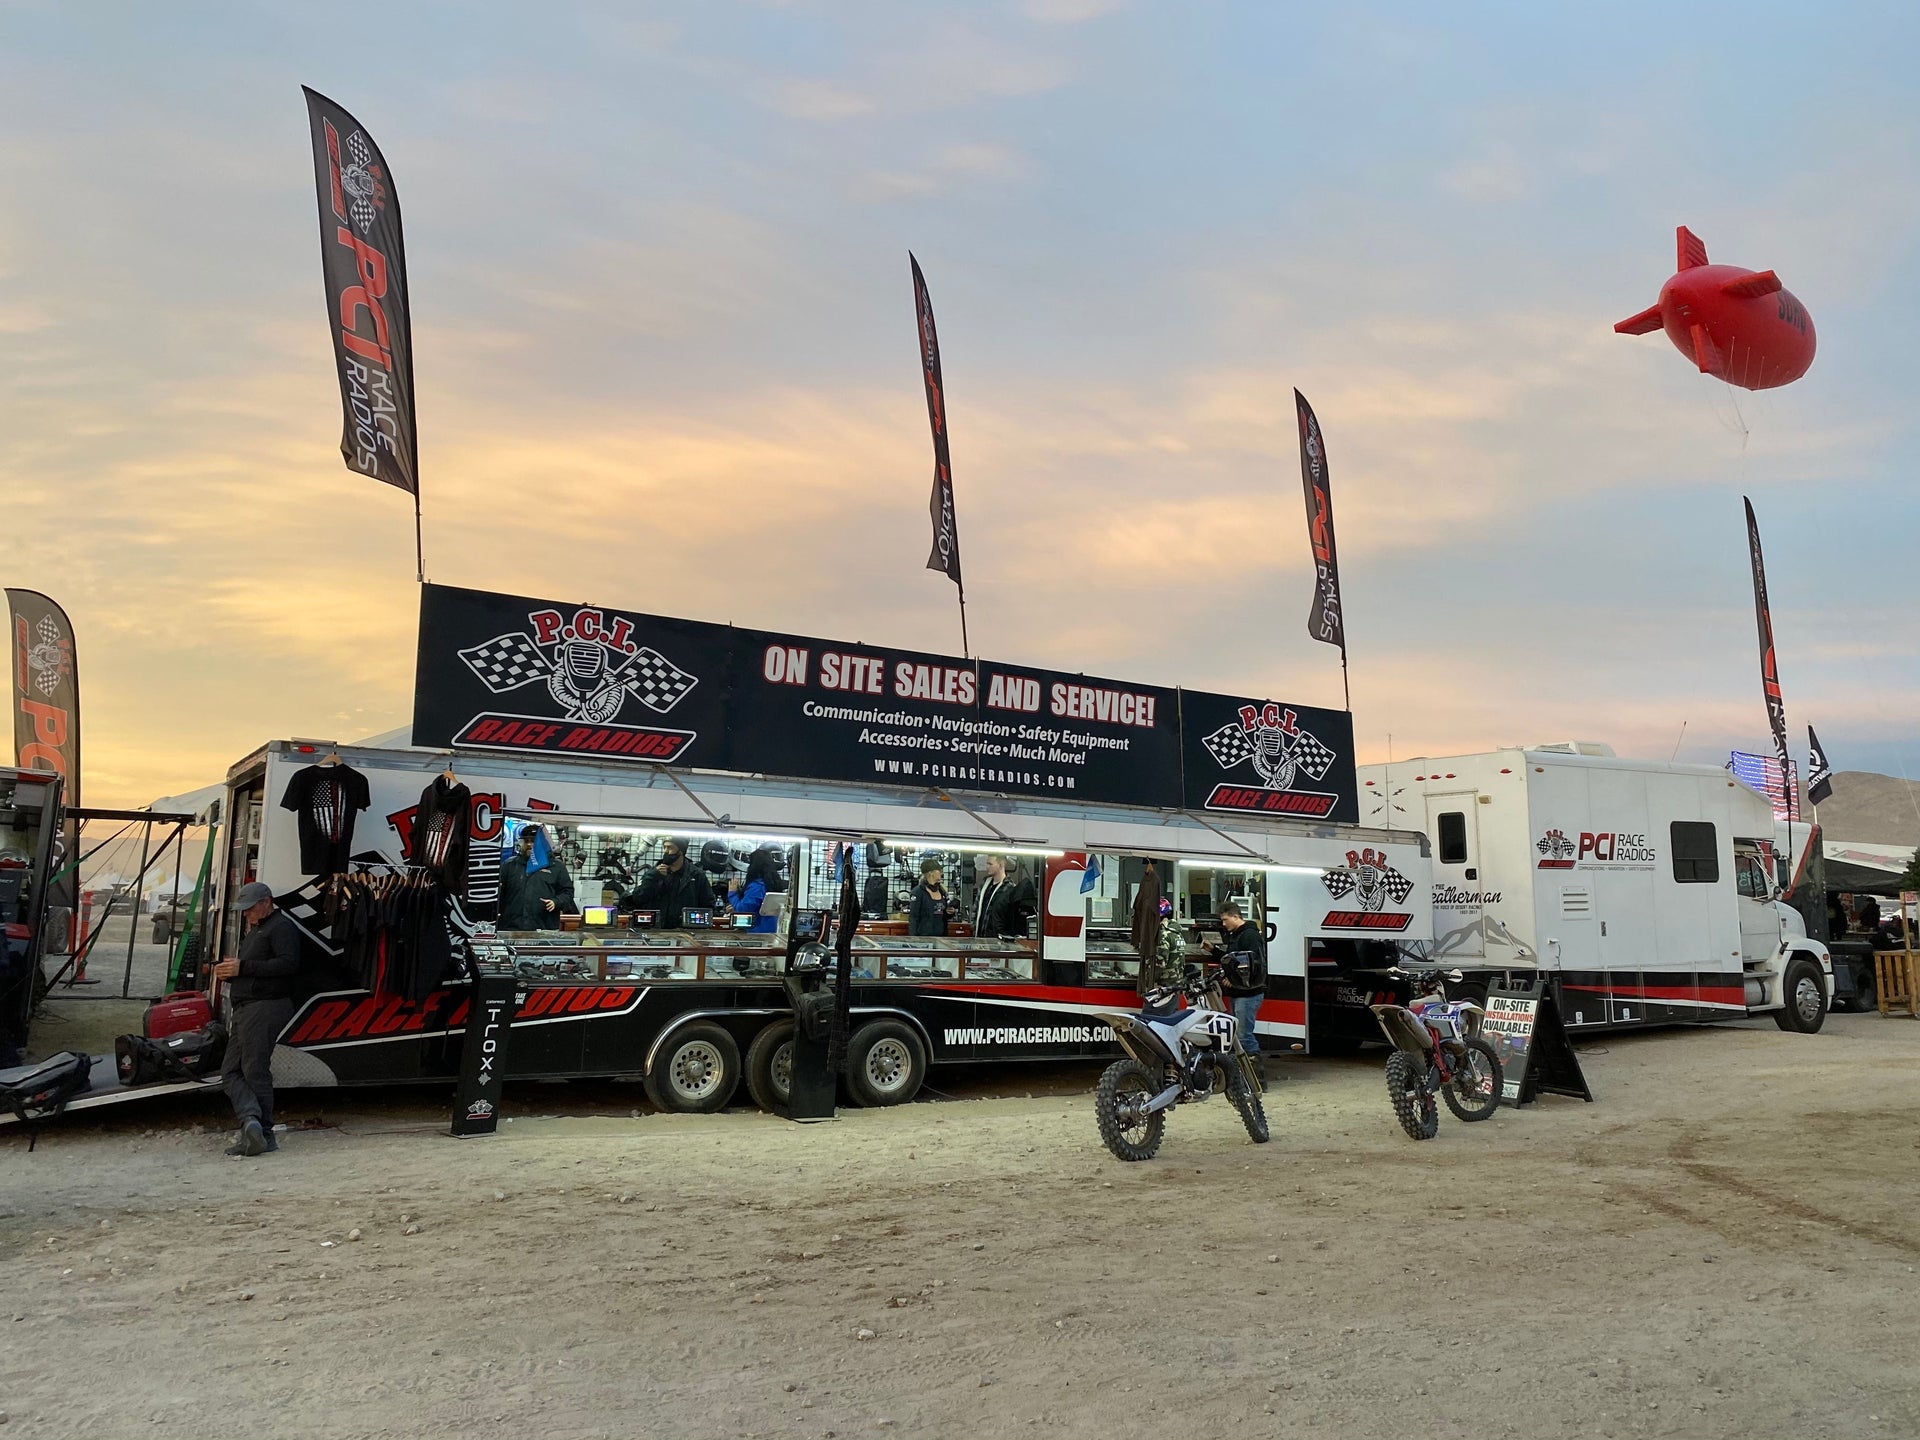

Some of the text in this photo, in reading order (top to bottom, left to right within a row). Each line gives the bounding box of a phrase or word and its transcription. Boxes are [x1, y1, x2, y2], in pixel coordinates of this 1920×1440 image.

[337, 226, 392, 371] PCI
[345, 356, 378, 475] RADIOS
[371, 369, 397, 456] RACE
[529, 609, 637, 654] P.C.I.
[763, 645, 1157, 728] ON SITE SALES AND SERVICE!
[803, 701, 1130, 751] Communication Navigation Safety Equipment
[1238, 703, 1301, 737] P.C.I.
[466, 719, 682, 756] RACE RADIOS
[858, 728, 1086, 765] Accessories Service Much More!
[874, 759, 1075, 789] WWW.PCIRACERADIOS.COM
[1212, 787, 1332, 814] RACE RADIOS
[1345, 848, 1388, 872] P.C.I.
[1578, 832, 1645, 861] PCI RACE
[1617, 848, 1656, 861] RADIOS
[1324, 912, 1408, 928] RACE RADIOS
[1337, 995, 1364, 1004] RADIOS
[1338, 987, 1357, 995] RACE
[1493, 999, 1531, 1012] ON-SITE
[1483, 1020, 1532, 1034] AVAILABLE!
[1485, 1011, 1534, 1022] INSTALLATIONS
